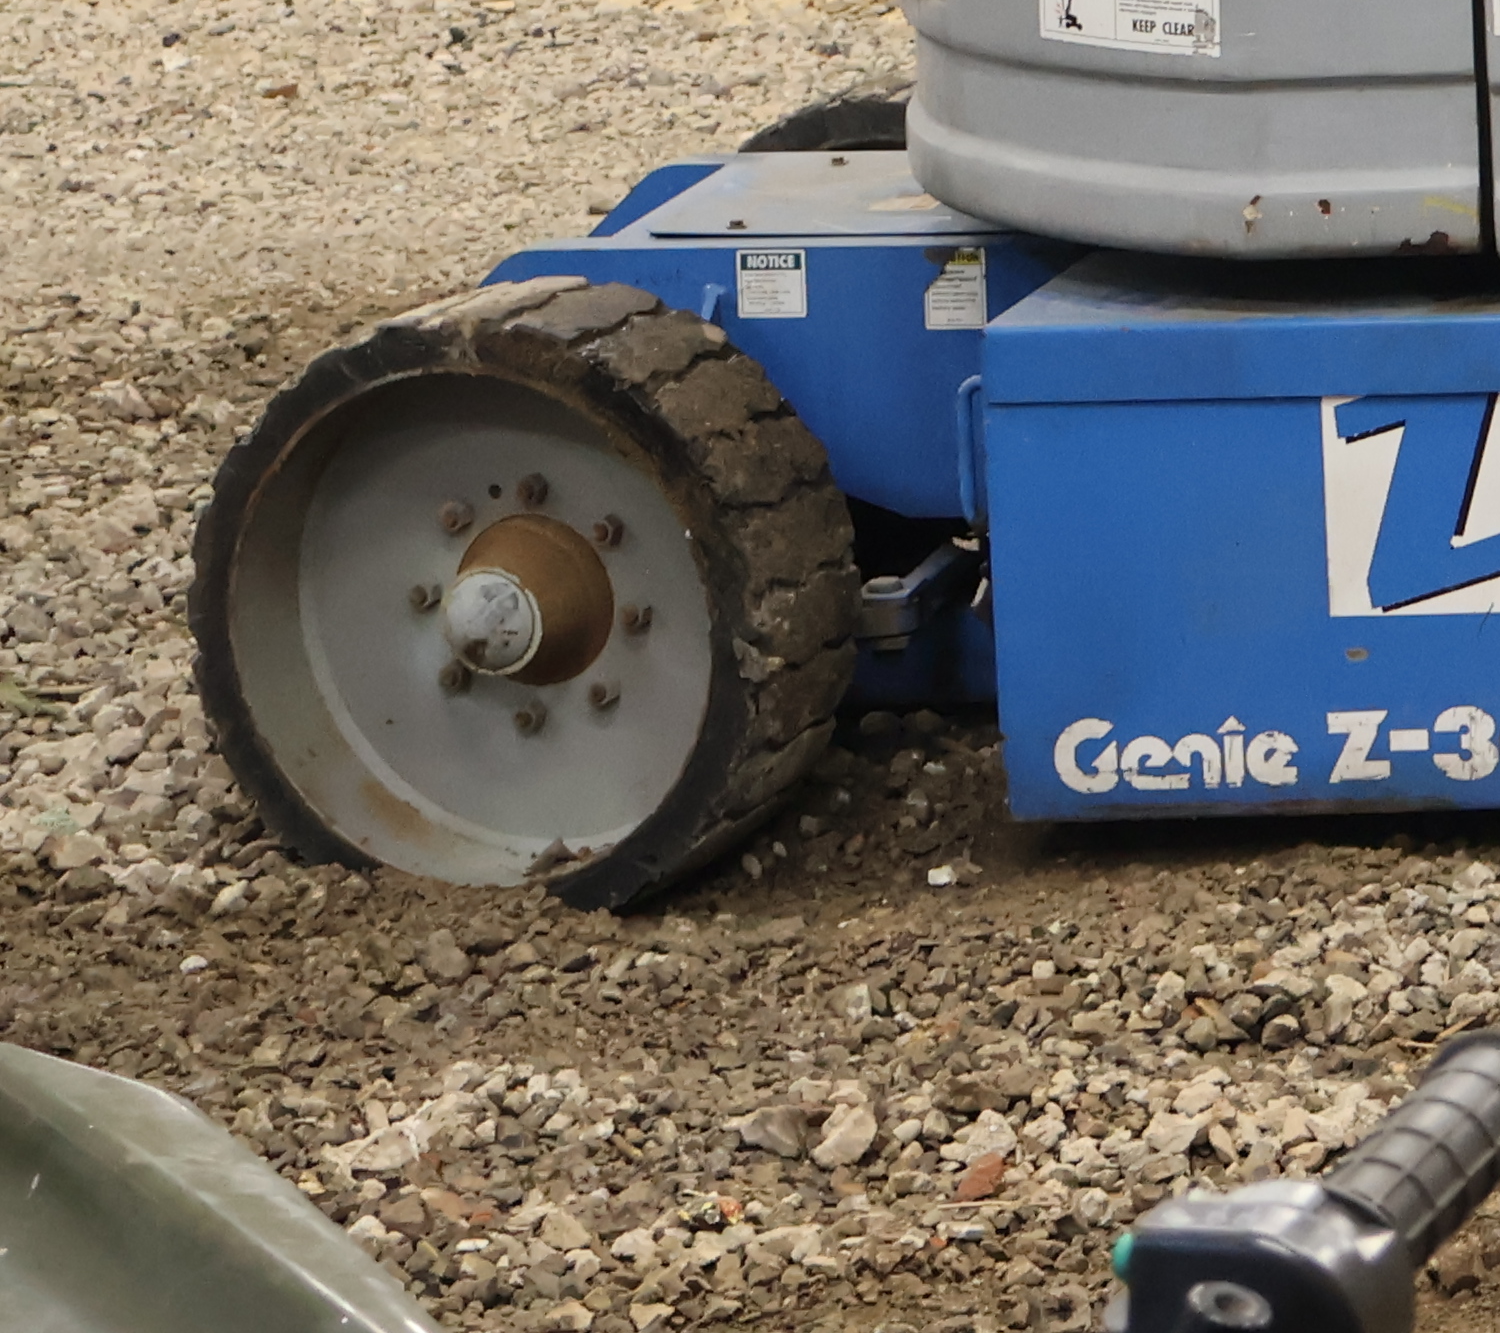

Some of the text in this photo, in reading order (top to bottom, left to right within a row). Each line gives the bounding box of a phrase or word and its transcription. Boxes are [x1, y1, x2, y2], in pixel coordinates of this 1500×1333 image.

[1132, 19, 1195, 37] KEEP CLEAR
[746, 254, 795, 269] NOTICE
[1053, 714, 1298, 796] Genie
